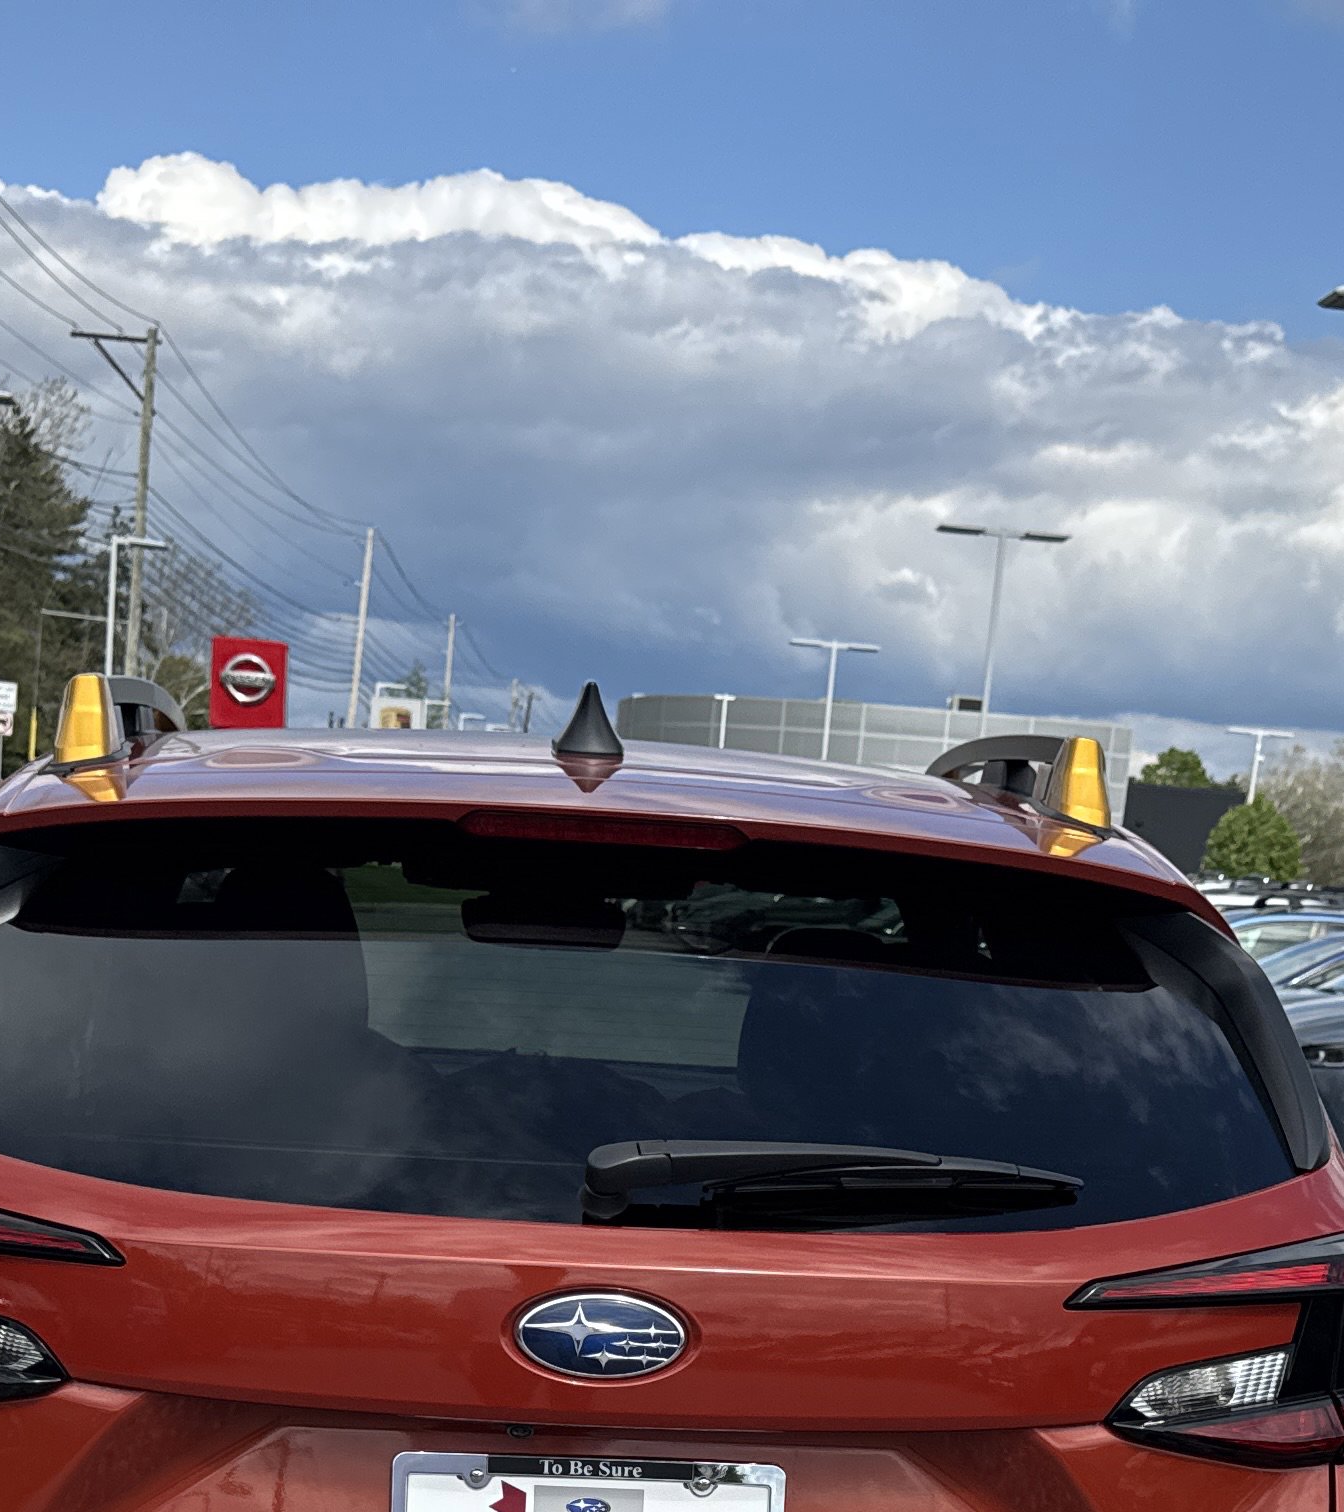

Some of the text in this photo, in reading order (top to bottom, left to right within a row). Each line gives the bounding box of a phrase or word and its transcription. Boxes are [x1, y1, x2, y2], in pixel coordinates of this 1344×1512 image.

[539, 1459, 643, 1478] To Be Sure
